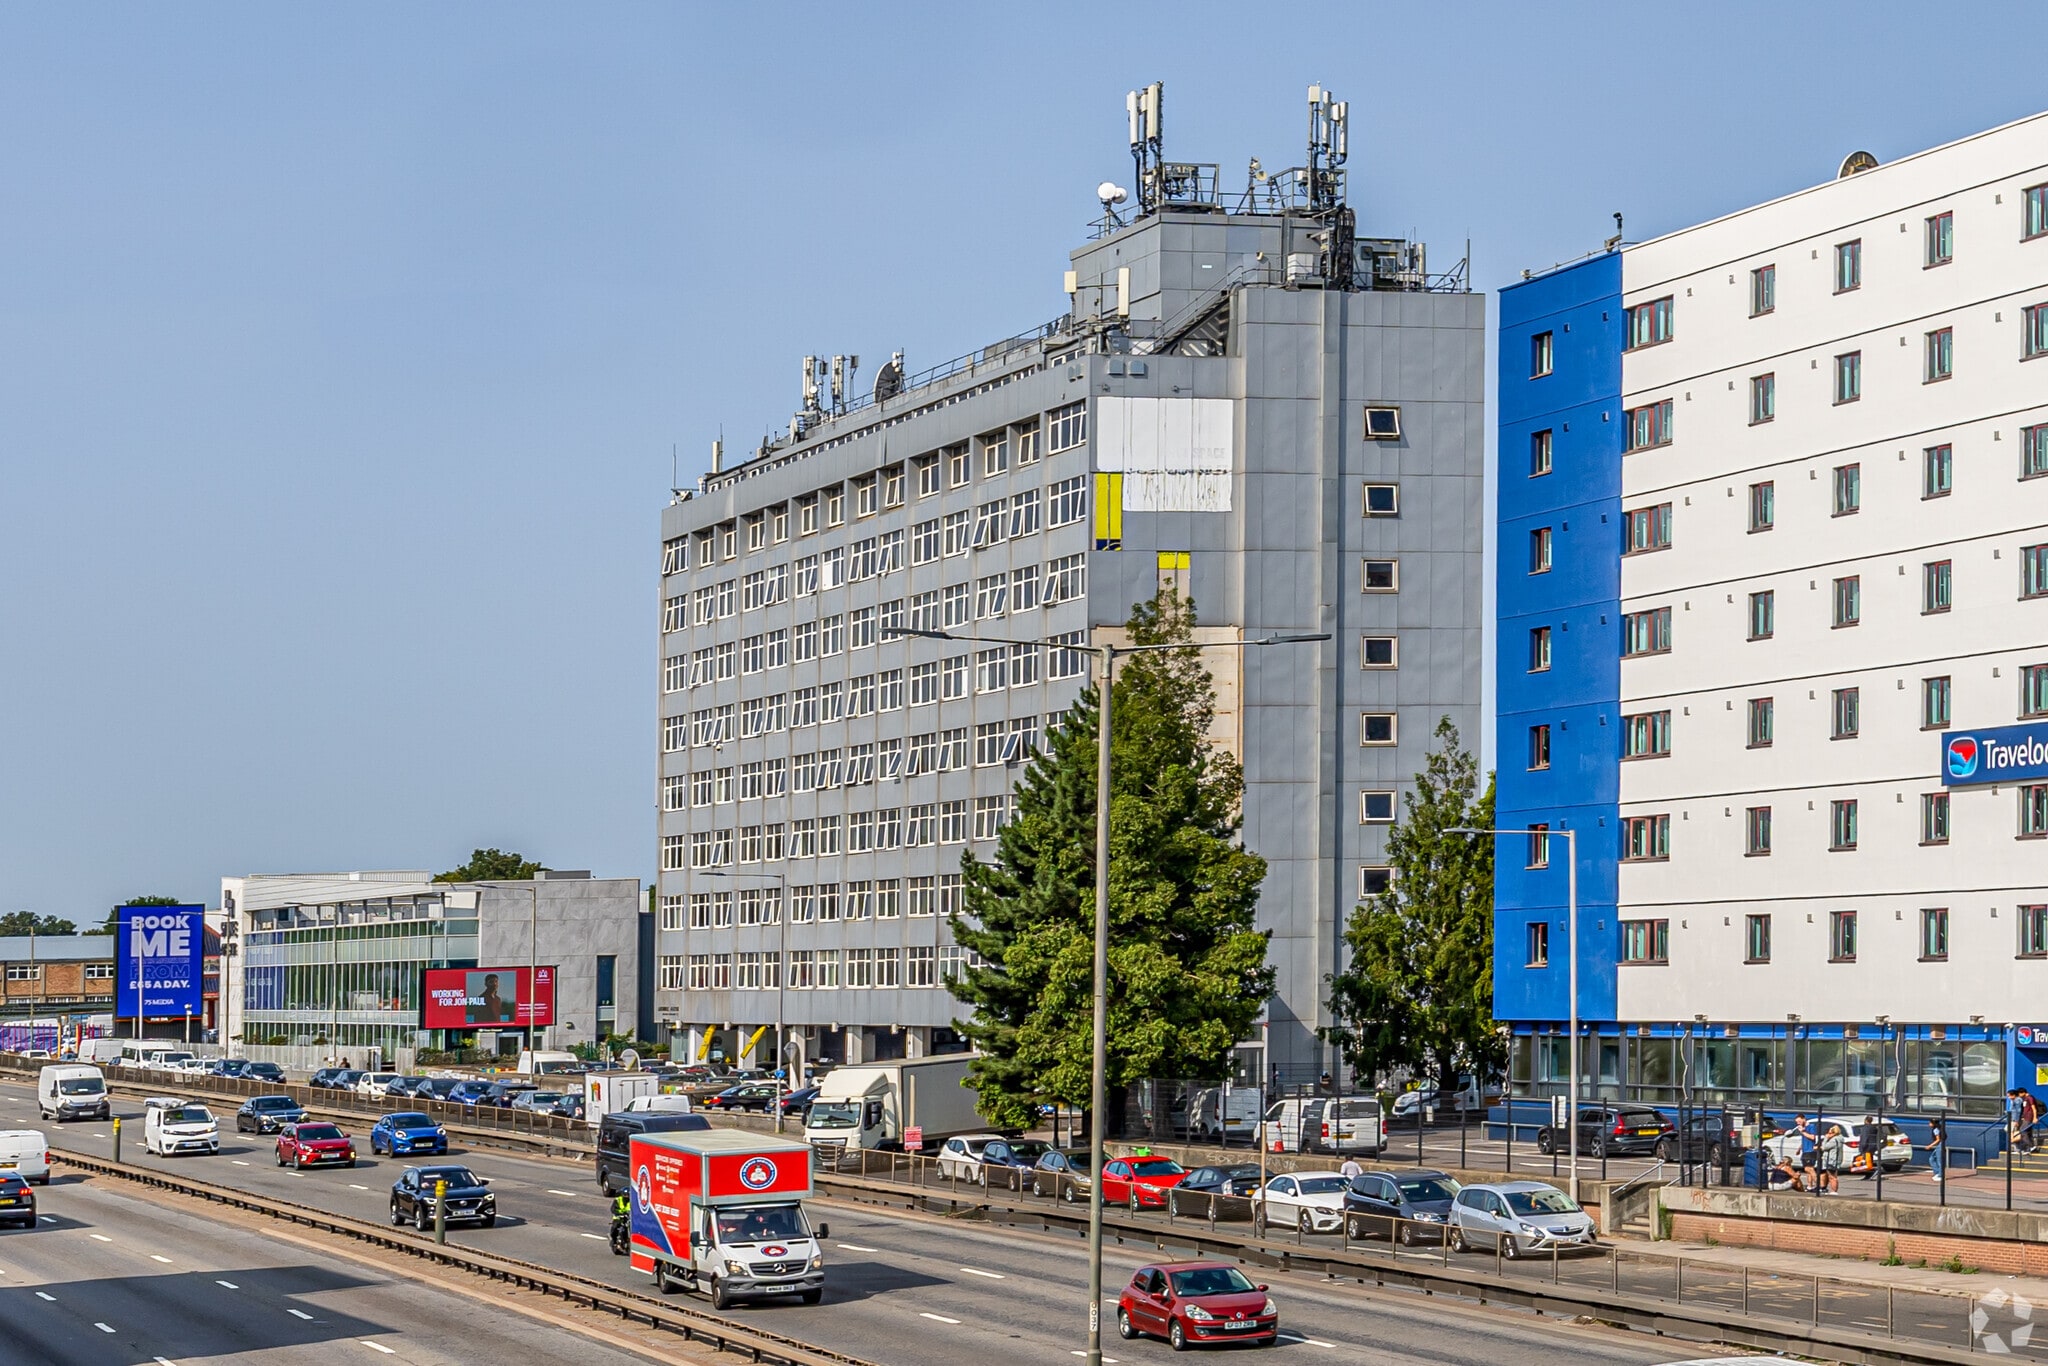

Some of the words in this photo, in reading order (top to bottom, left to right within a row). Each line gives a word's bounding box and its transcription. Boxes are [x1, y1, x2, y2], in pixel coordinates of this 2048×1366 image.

[130, 915, 190, 930] BOOK
[130, 930, 191, 957] ME
[129, 964, 190, 980] FROM
[153, 980, 163, 989] A
[163, 979, 191, 989] DAY.
[431, 989, 465, 998] WORKING
[438, 998, 453, 1006] FOR
